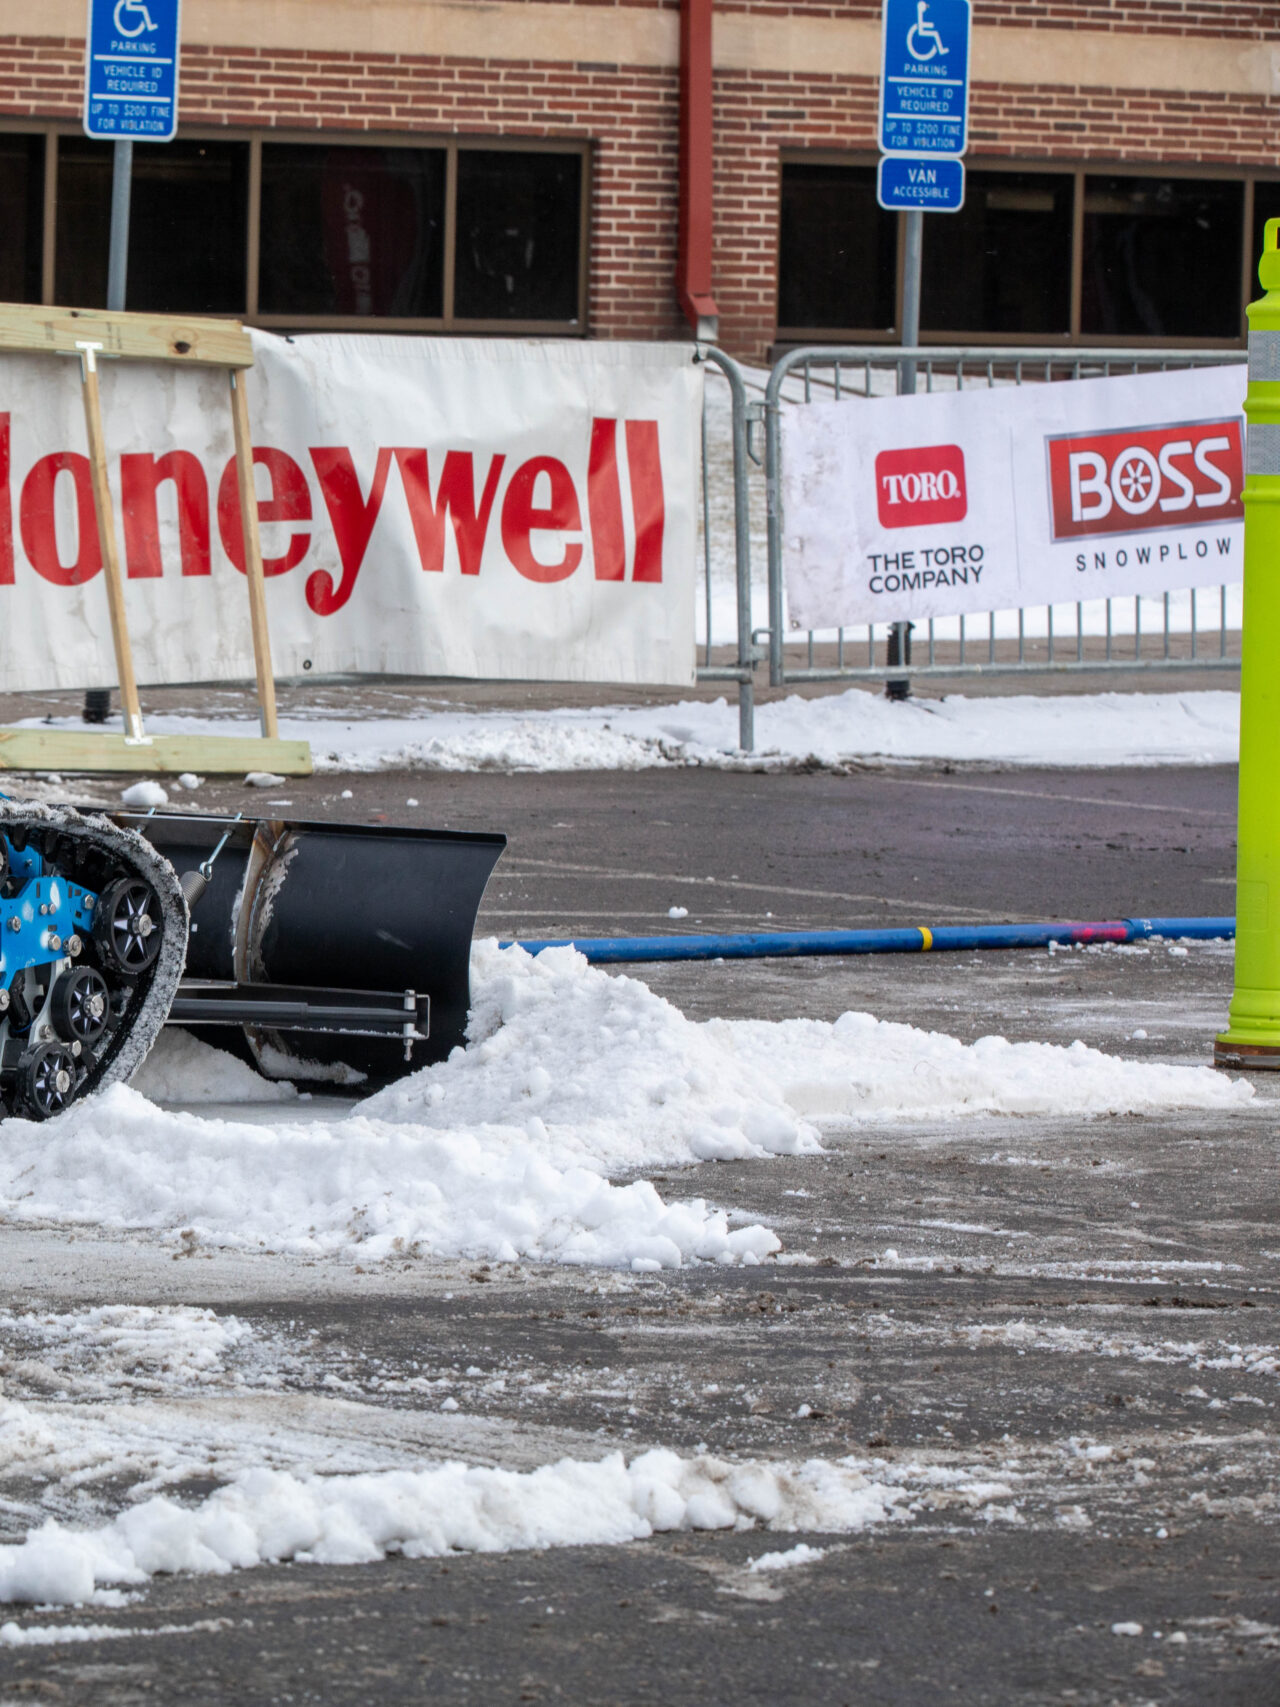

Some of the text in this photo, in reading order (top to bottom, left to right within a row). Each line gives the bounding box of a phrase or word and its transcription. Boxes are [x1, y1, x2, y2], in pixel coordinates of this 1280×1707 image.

[110, 40, 157, 54] PARKING
[103, 64, 163, 79] VEHICLE ID
[904, 63, 948, 76] PARKING
[106, 79, 159, 93] REQUIRED
[897, 86, 954, 99] VEHICLE ID
[91, 103, 171, 118] UP TO $200 FINE
[900, 100, 949, 112] REQUIRED
[97, 118, 165, 132] FOR VIOLATION
[885, 122, 961, 136] UP TO $200 FINE
[891, 135, 956, 148] FOR VIOLATION
[908, 168, 937, 184] VAN
[893, 186, 950, 199] ACCESSIBLE
[1069, 436, 1232, 522] BOSS
[867, 544, 985, 573] THE TORO
[1076, 537, 1232, 572] SNOWPLOW
[869, 565, 983, 594] COMPANY
